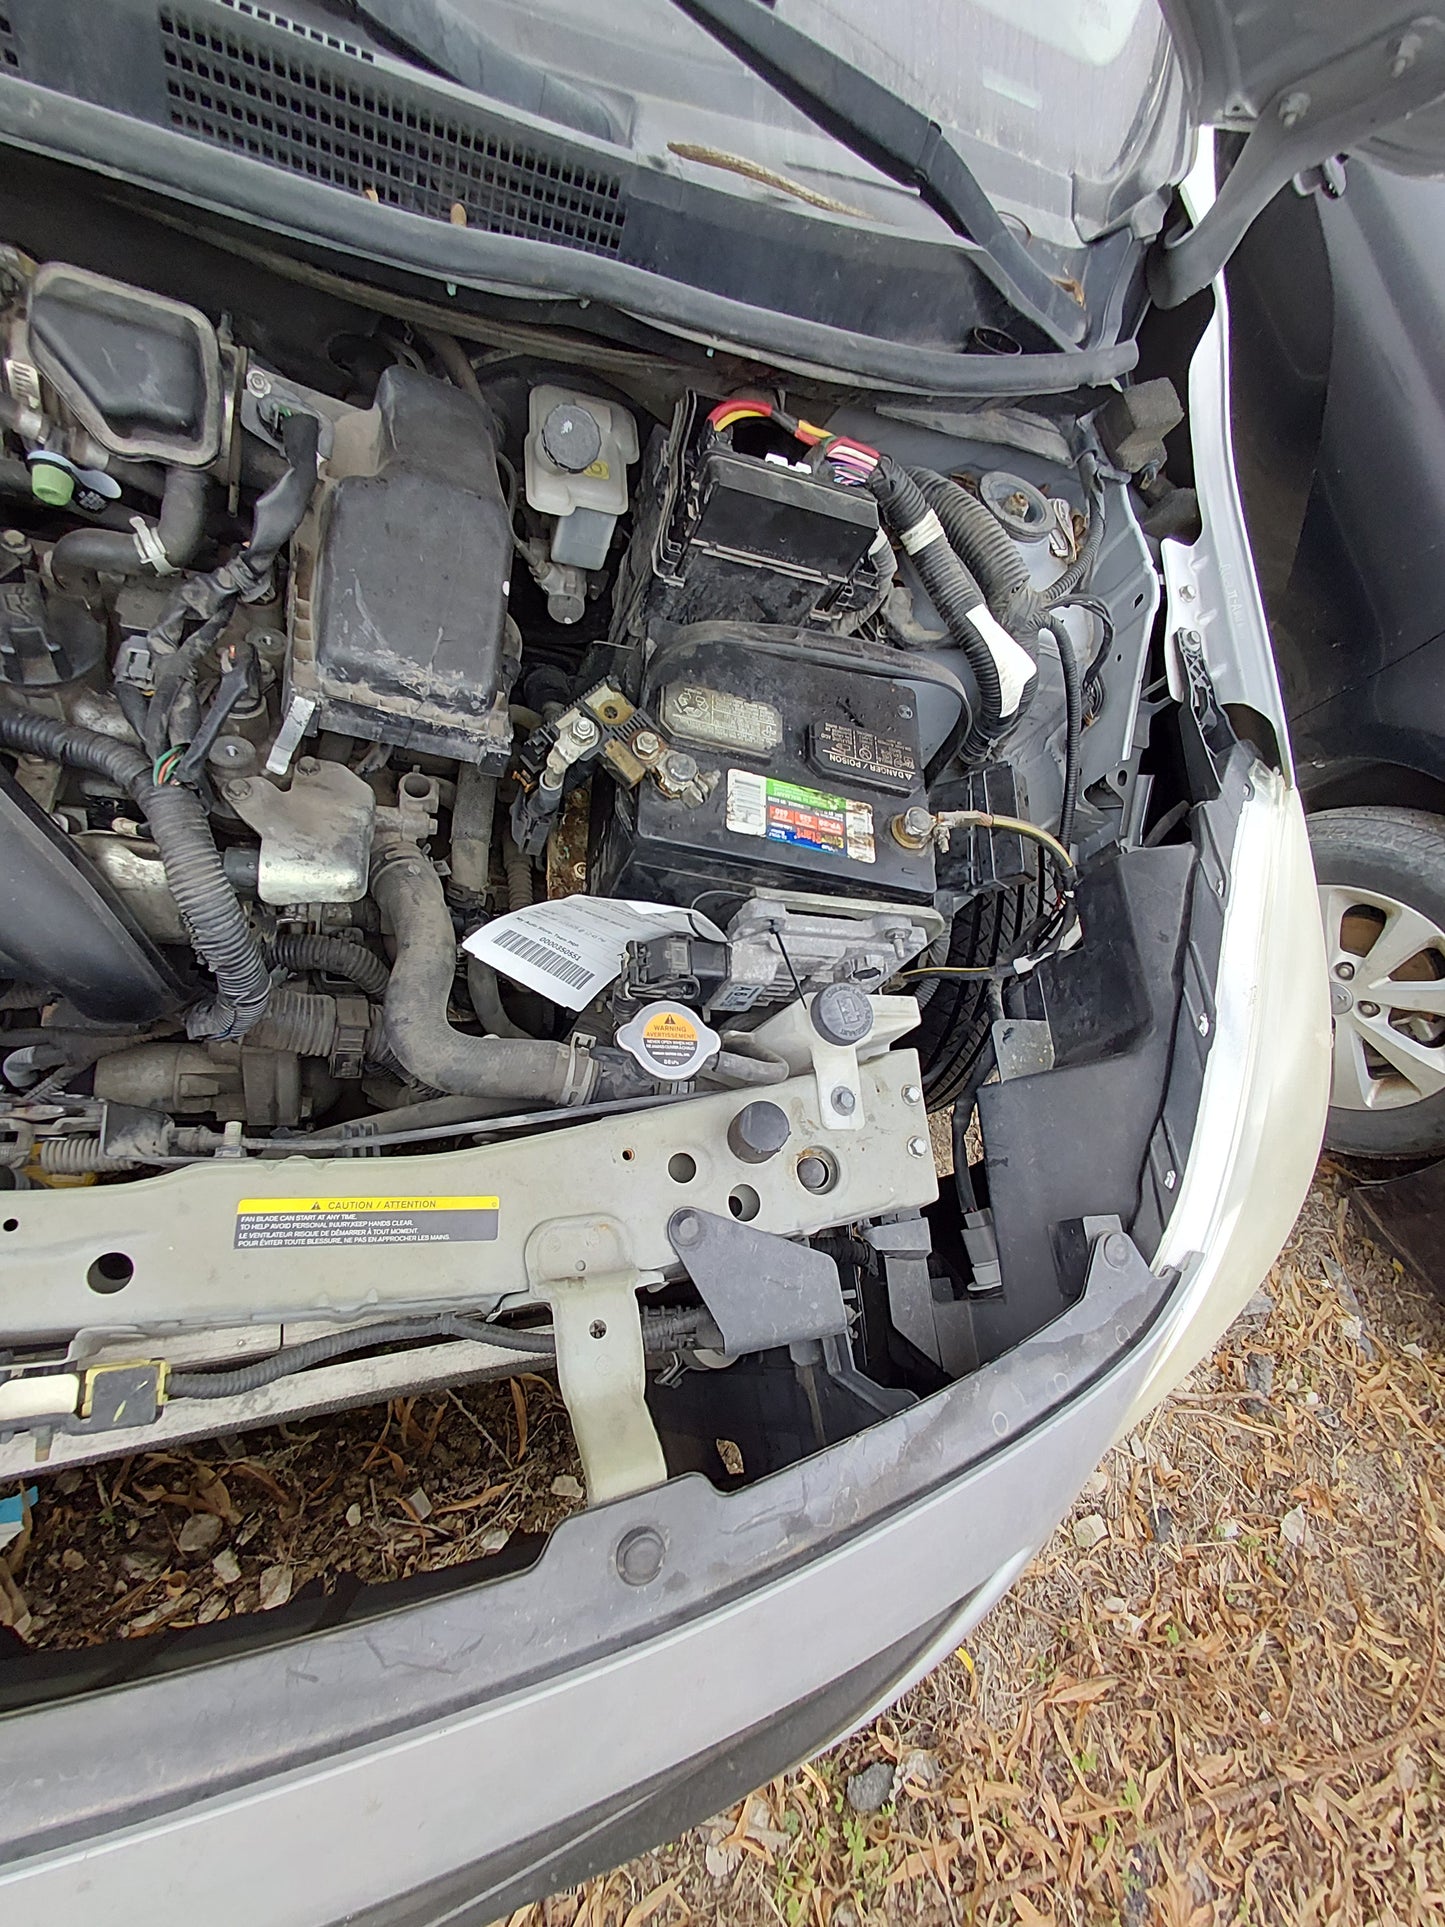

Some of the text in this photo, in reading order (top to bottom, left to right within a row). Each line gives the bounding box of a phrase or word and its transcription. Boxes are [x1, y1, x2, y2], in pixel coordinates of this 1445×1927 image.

[829, 753, 862, 768] POISON
[869, 764, 905, 779] DANGER
[538, 935, 582, 962] 0000350551
[328, 1200, 436, 1210] CAUTION / ATTENTION
[331, 1228, 366, 1236] DÉMARRER
[259, 1238, 283, 1246] ÉVITER
